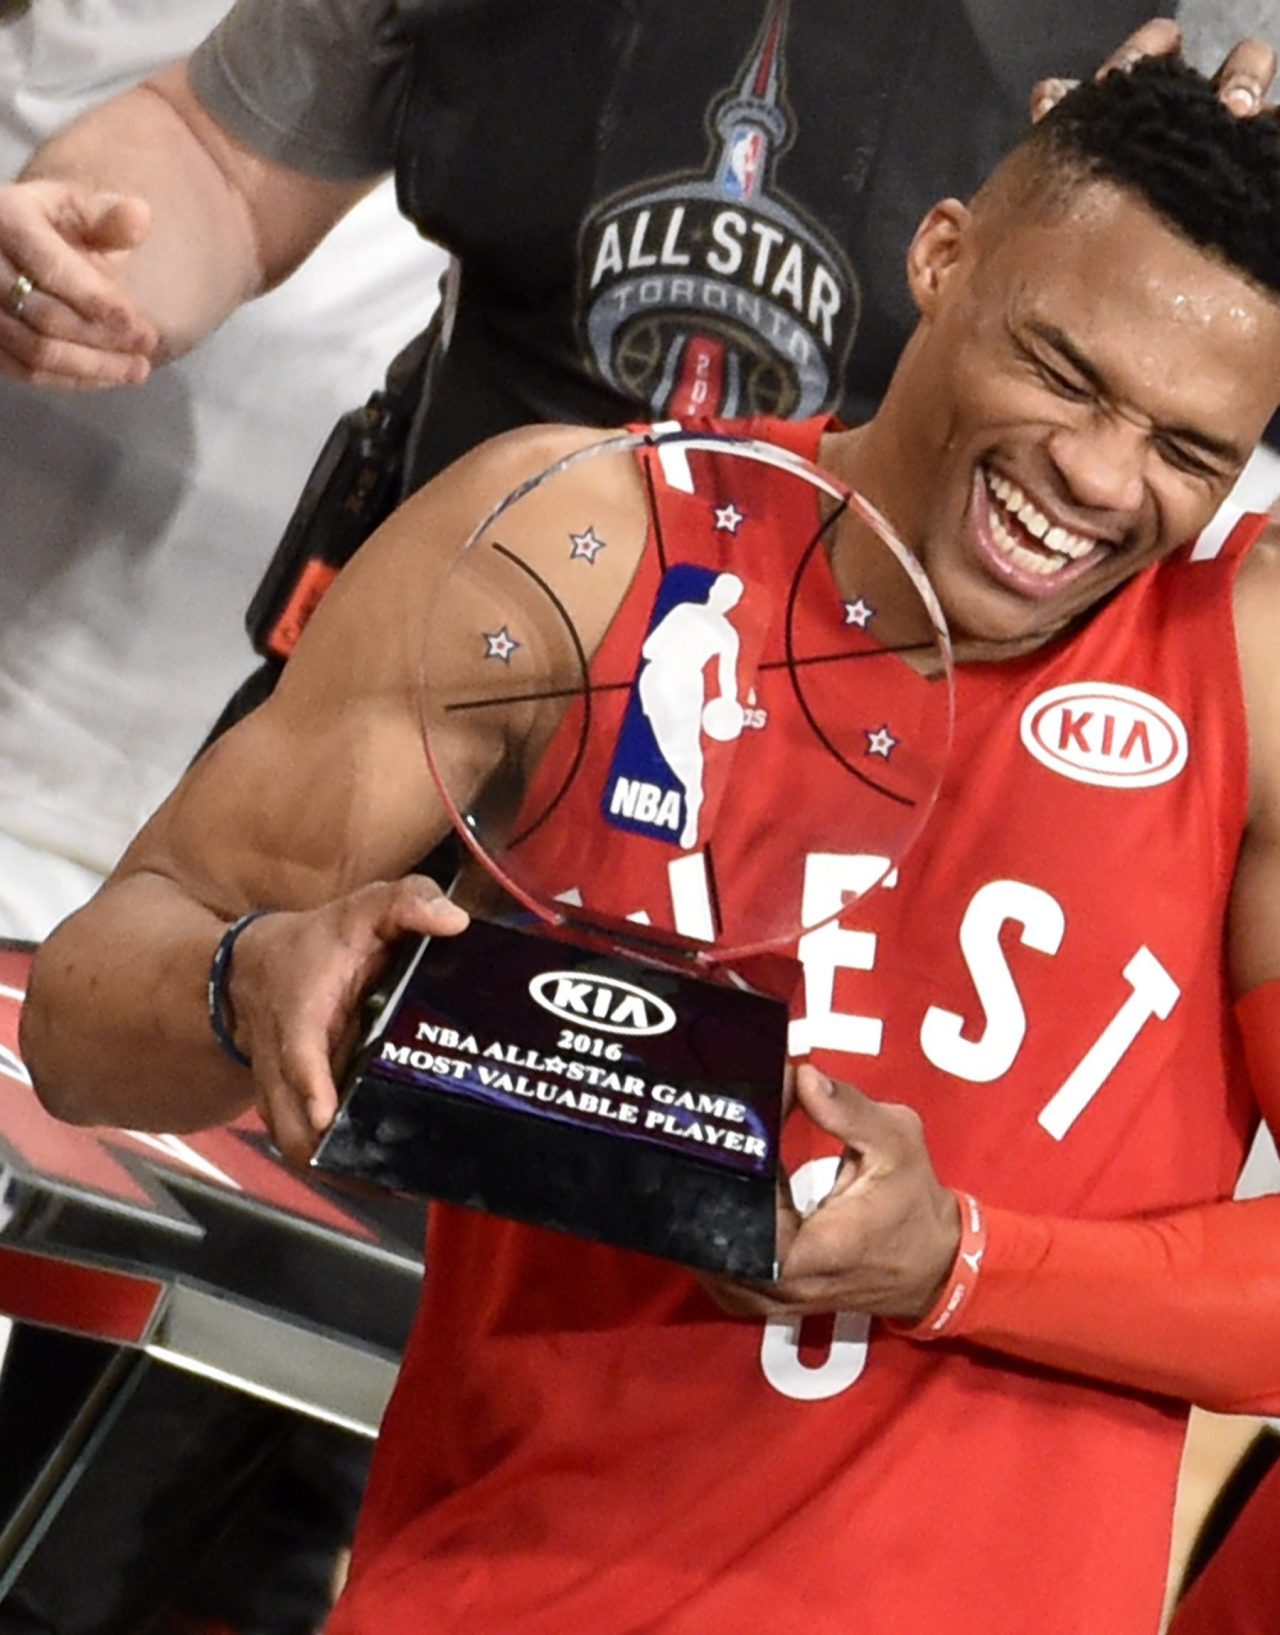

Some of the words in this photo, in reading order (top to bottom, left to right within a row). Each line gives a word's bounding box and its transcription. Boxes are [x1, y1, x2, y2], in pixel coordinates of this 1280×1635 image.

[590, 206, 690, 289] ALL
[706, 211, 841, 346] STAR
[613, 278, 809, 366] TORONTO
[1057, 709, 1153, 763] KIA
[609, 777, 682, 829] NBA
[553, 978, 648, 1029] KIA
[415, 1021, 479, 1054] NBA
[651, 1083, 747, 1123] GAME
[557, 1029, 624, 1062] 2016
[380, 1042, 472, 1079] MOST
[478, 1065, 640, 1125] VALUABLE
[644, 1109, 767, 1158] PLAYER
